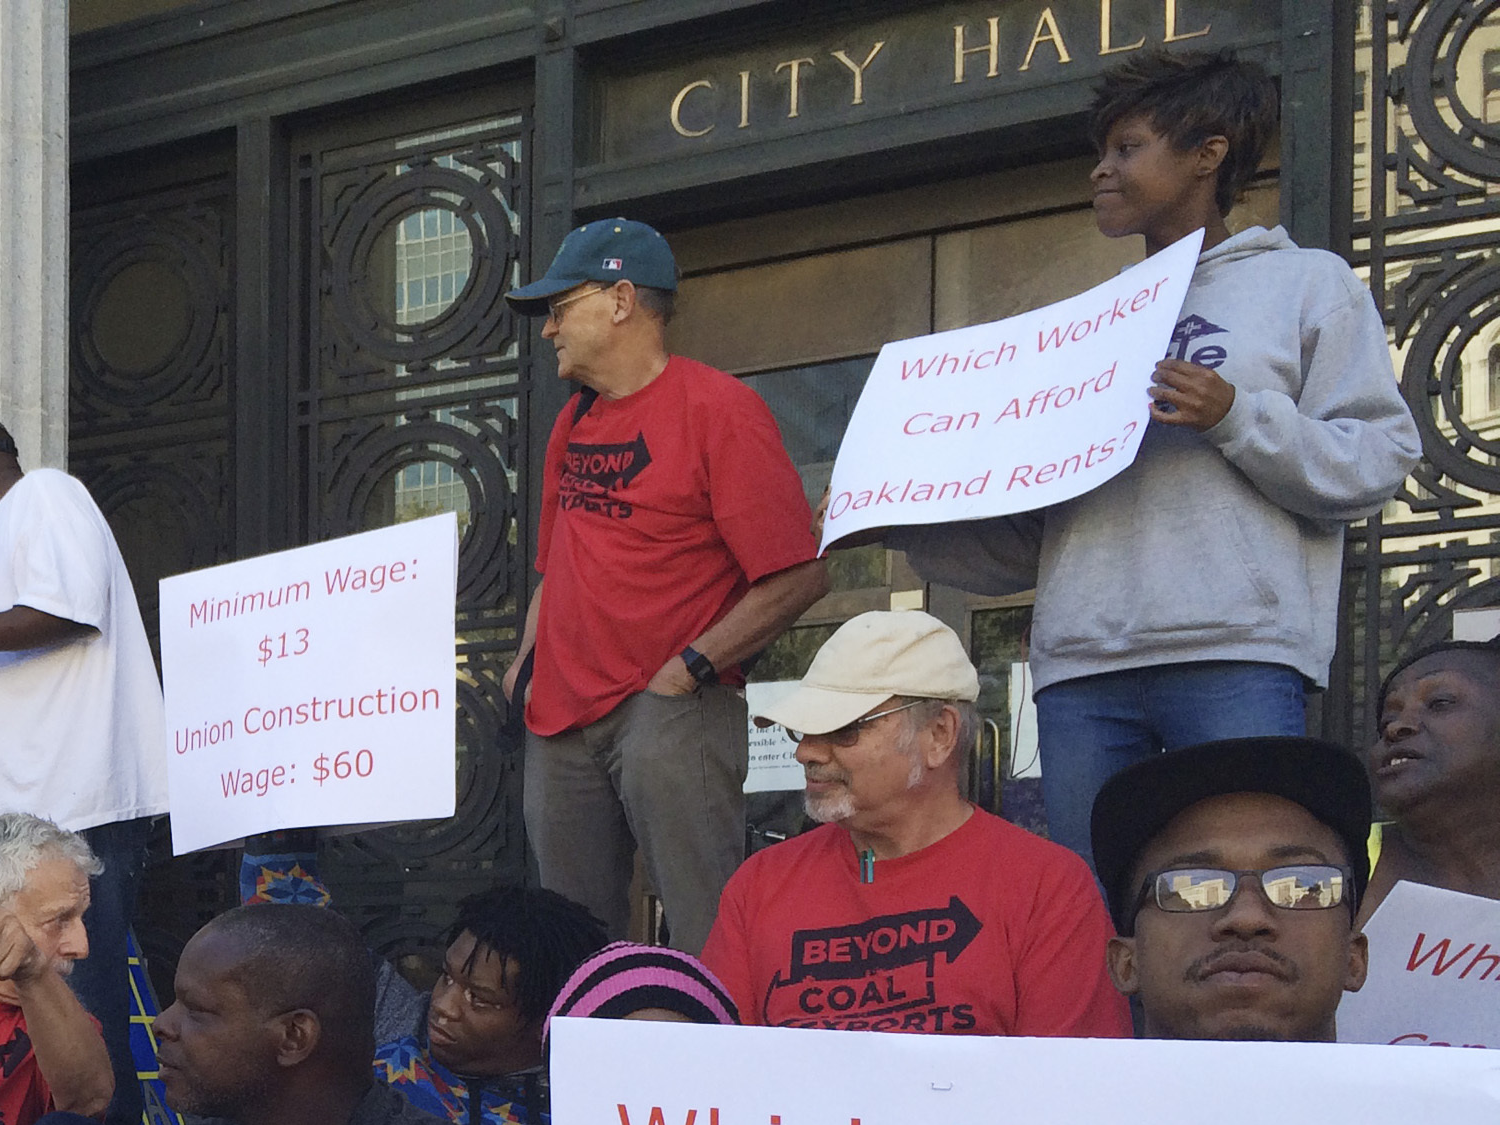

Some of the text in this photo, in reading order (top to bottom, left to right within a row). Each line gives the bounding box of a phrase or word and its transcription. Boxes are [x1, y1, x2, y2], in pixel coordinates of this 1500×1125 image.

[670, 0, 1211, 137] CITY HALL
[901, 276, 1169, 382] Which Worker
[903, 360, 1118, 436] Can Afford
[828, 420, 1138, 522] Oakland Rents?
[189, 558, 418, 628] Minimum Wage:
[257, 628, 311, 667] $13
[175, 686, 440, 755] Union Construction
[220, 749, 374, 798] Wage: $60
[802, 918, 957, 966] BEYOND
[1406, 932, 1500, 981] Wh
[799, 976, 907, 1015] COAL
